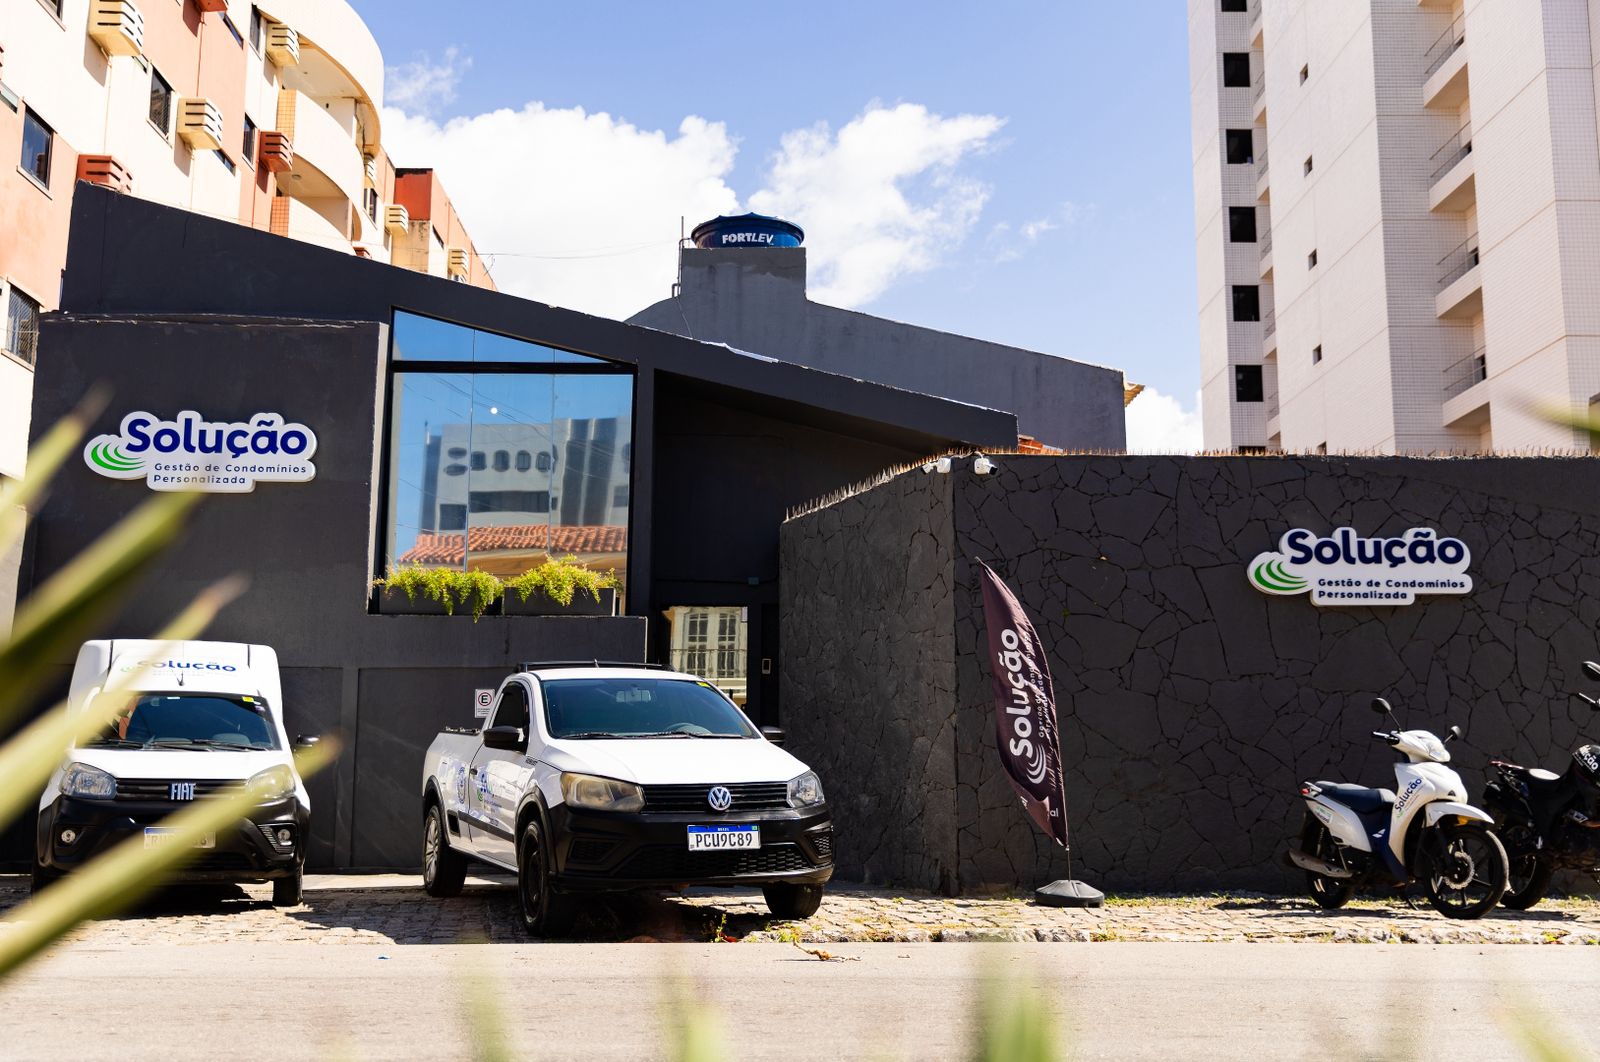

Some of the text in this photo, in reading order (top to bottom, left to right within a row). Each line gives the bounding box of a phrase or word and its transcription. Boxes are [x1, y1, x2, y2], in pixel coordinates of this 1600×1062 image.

[722, 233, 774, 244] FORTLEV
[125, 417, 307, 458] Solução
[154, 462, 306, 473] Gestão de Condomínios
[153, 474, 246, 484] Personalizada
[1287, 530, 1464, 567] Solução
[1318, 578, 1465, 588] Gestão de Condomínios
[1318, 590, 1407, 599] Personalizada
[998, 628, 1033, 758] Solução
[481, 695, 489, 704] E
[171, 782, 196, 800] FIAT
[695, 833, 753, 847] PCU9C89
